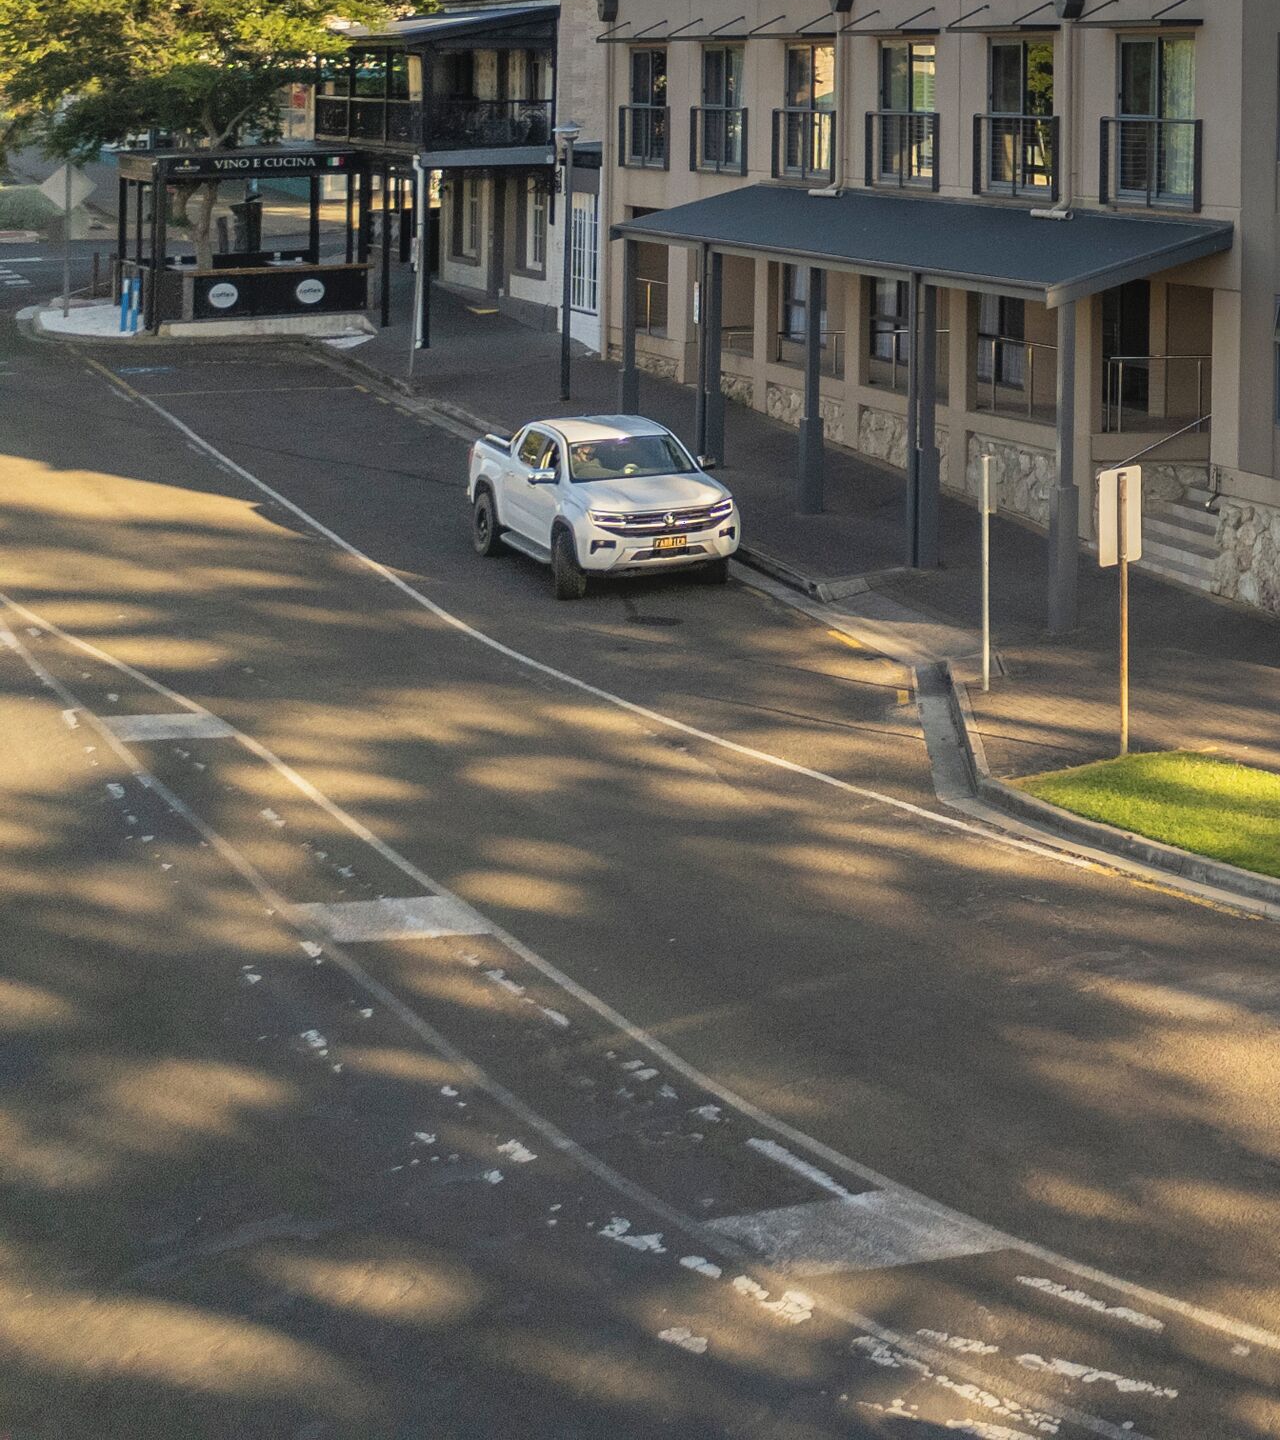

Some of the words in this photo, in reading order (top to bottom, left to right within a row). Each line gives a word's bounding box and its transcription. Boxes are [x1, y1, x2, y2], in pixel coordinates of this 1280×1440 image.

[214, 159, 249, 169] VINO
[253, 158, 261, 168] E
[264, 157, 316, 168] CUCINA
